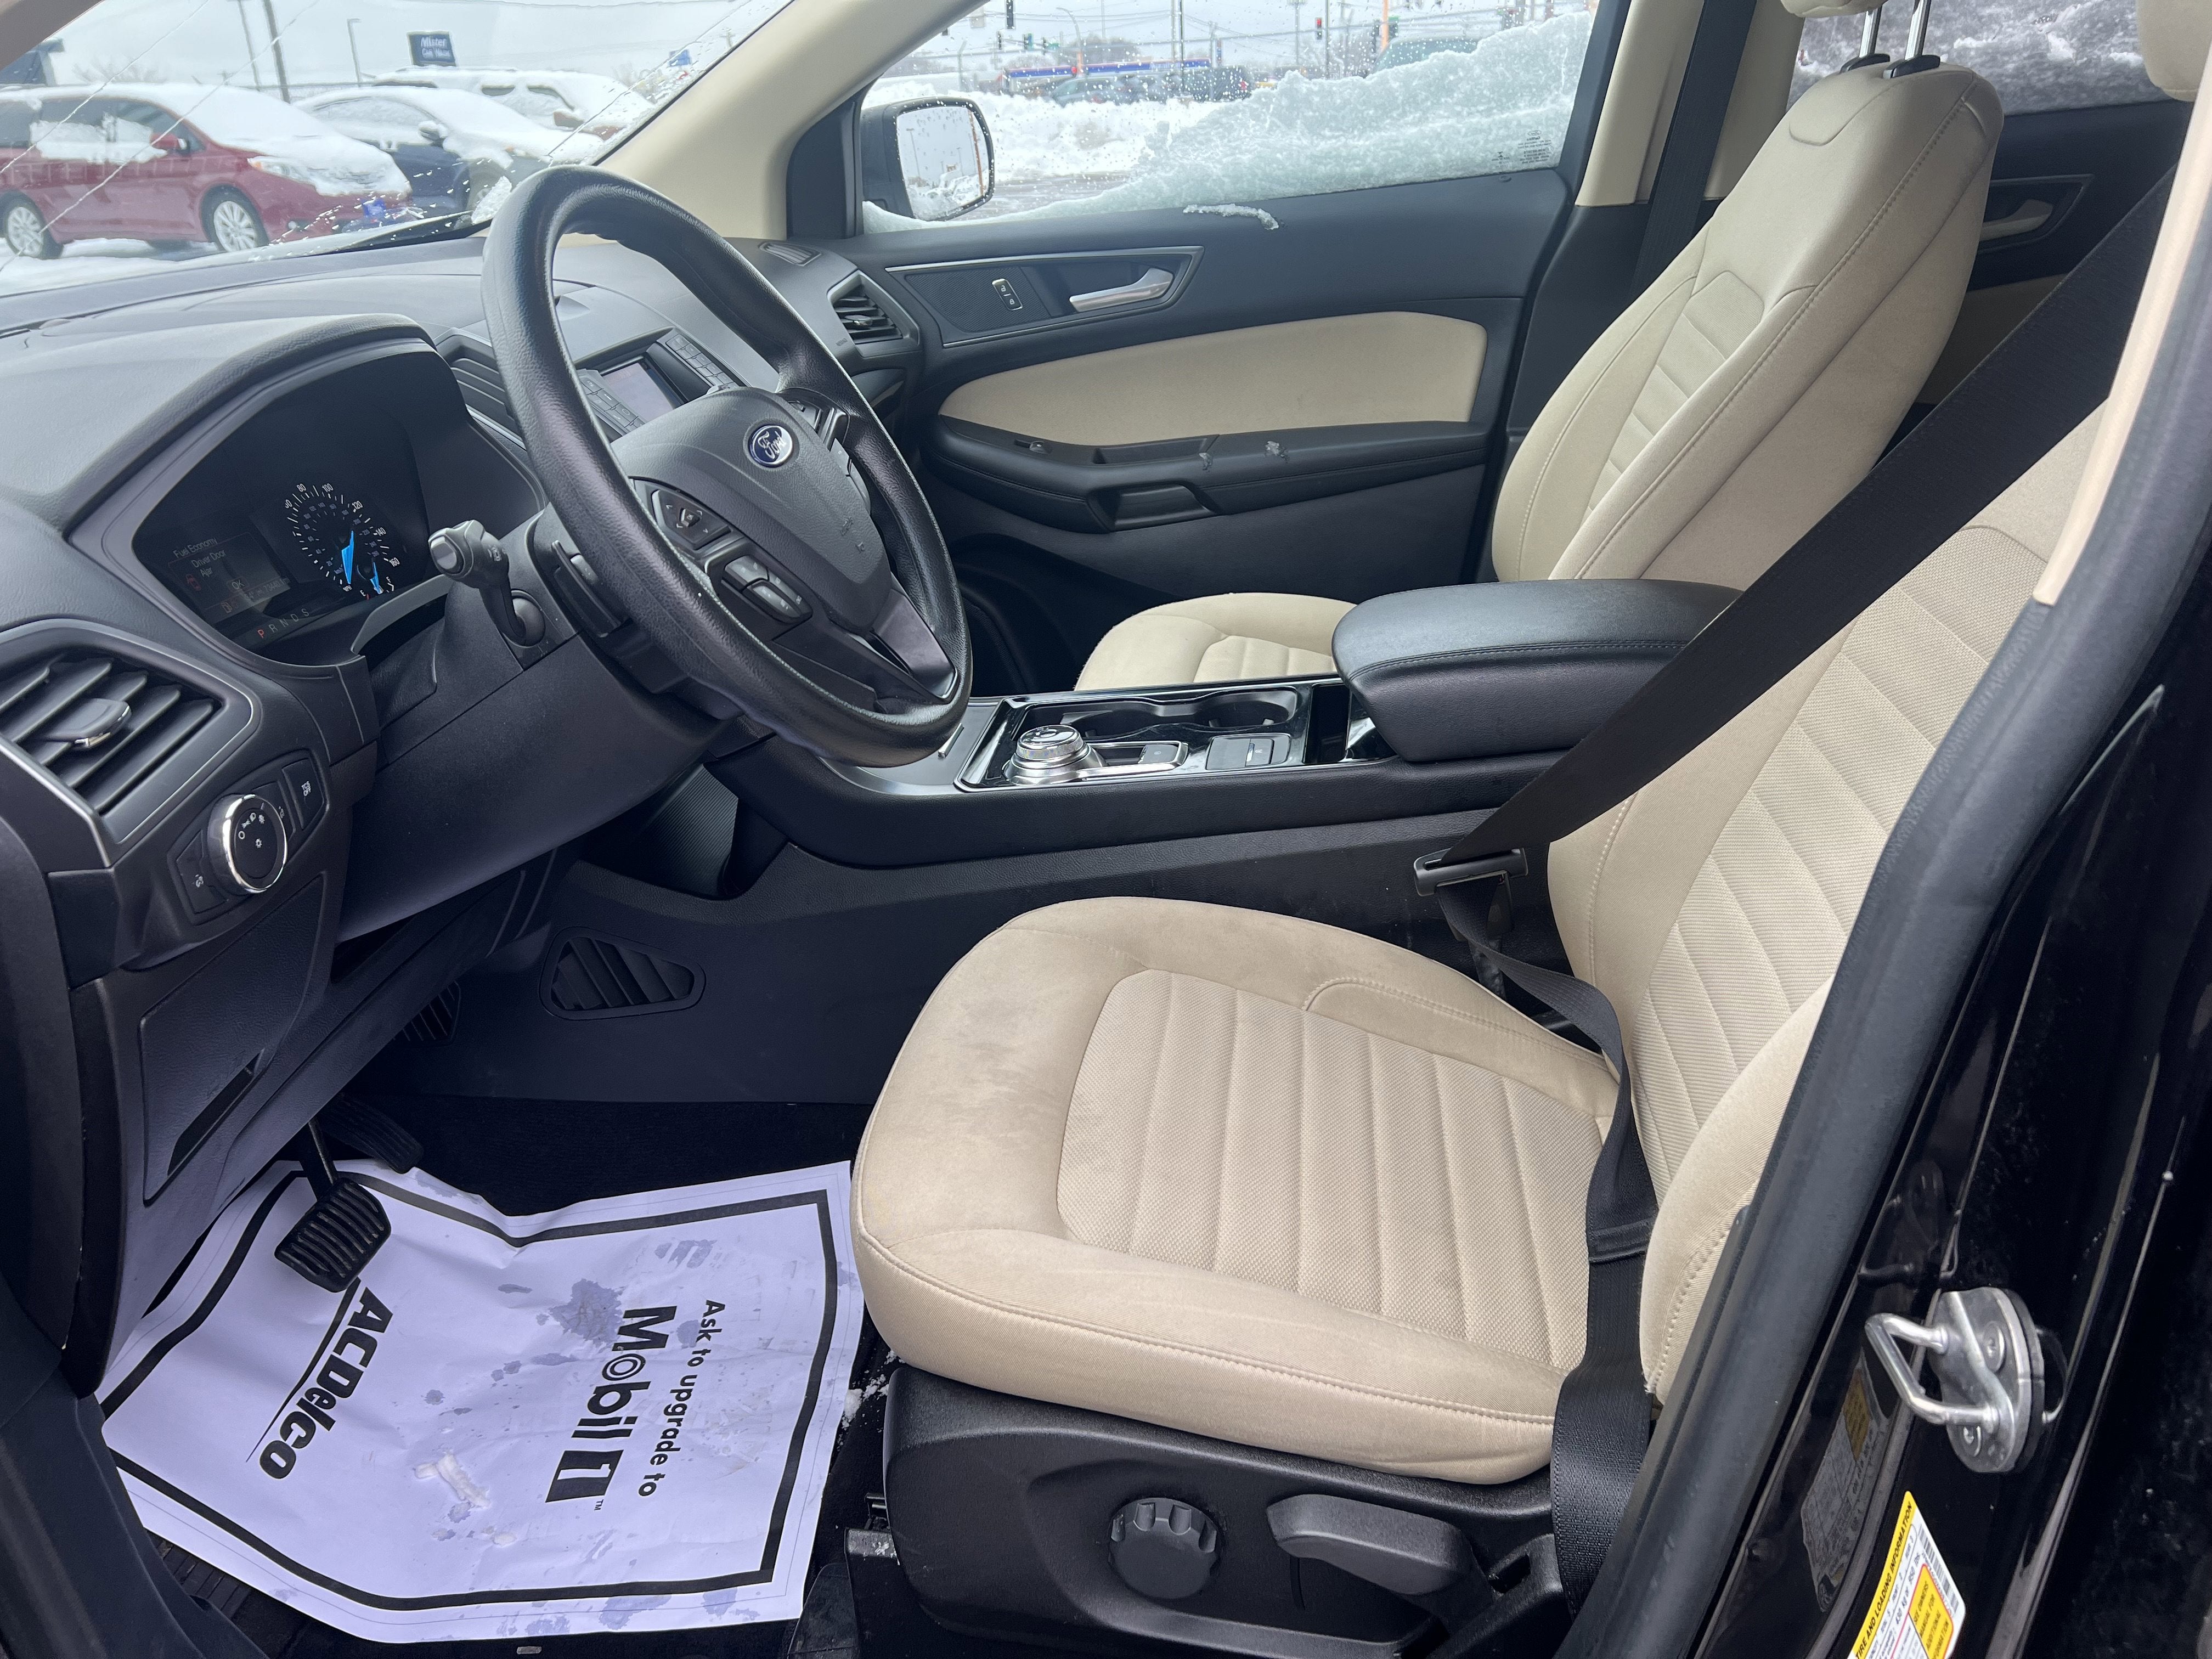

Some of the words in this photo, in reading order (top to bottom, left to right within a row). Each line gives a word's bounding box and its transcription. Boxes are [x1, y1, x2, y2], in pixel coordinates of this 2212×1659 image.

[420, 36, 447, 48] Mister
[296, 483, 307, 492] 80
[321, 483, 334, 493] 100
[352, 500, 363, 510] 120
[375, 527, 386, 536] 140
[173, 544, 190, 558] Fuel
[187, 537, 218, 554] Economy
[191, 556, 212, 568] Driver
[209, 549, 227, 561] Door
[389, 557, 400, 567] 160
[231, 579, 245, 590] OK
[257, 629, 265, 639] P
[268, 623, 278, 633] R
[279, 618, 289, 628] N
[290, 613, 299, 623] D
[301, 608, 309, 617] S
[695, 1299, 726, 1344] Ask
[687, 1348, 712, 1367] to
[571, 1305, 678, 1438] Mobil
[259, 1286, 394, 1480] ACDelco
[649, 1374, 698, 1466] upgrade
[638, 1474, 666, 1497] to
[1855, 1637, 1867, 1659] TIRE
[1866, 1616, 1876, 1640] AND
[1875, 1572, 1892, 1618] LOADING
[1889, 1500, 1912, 1574] INFORMATION
